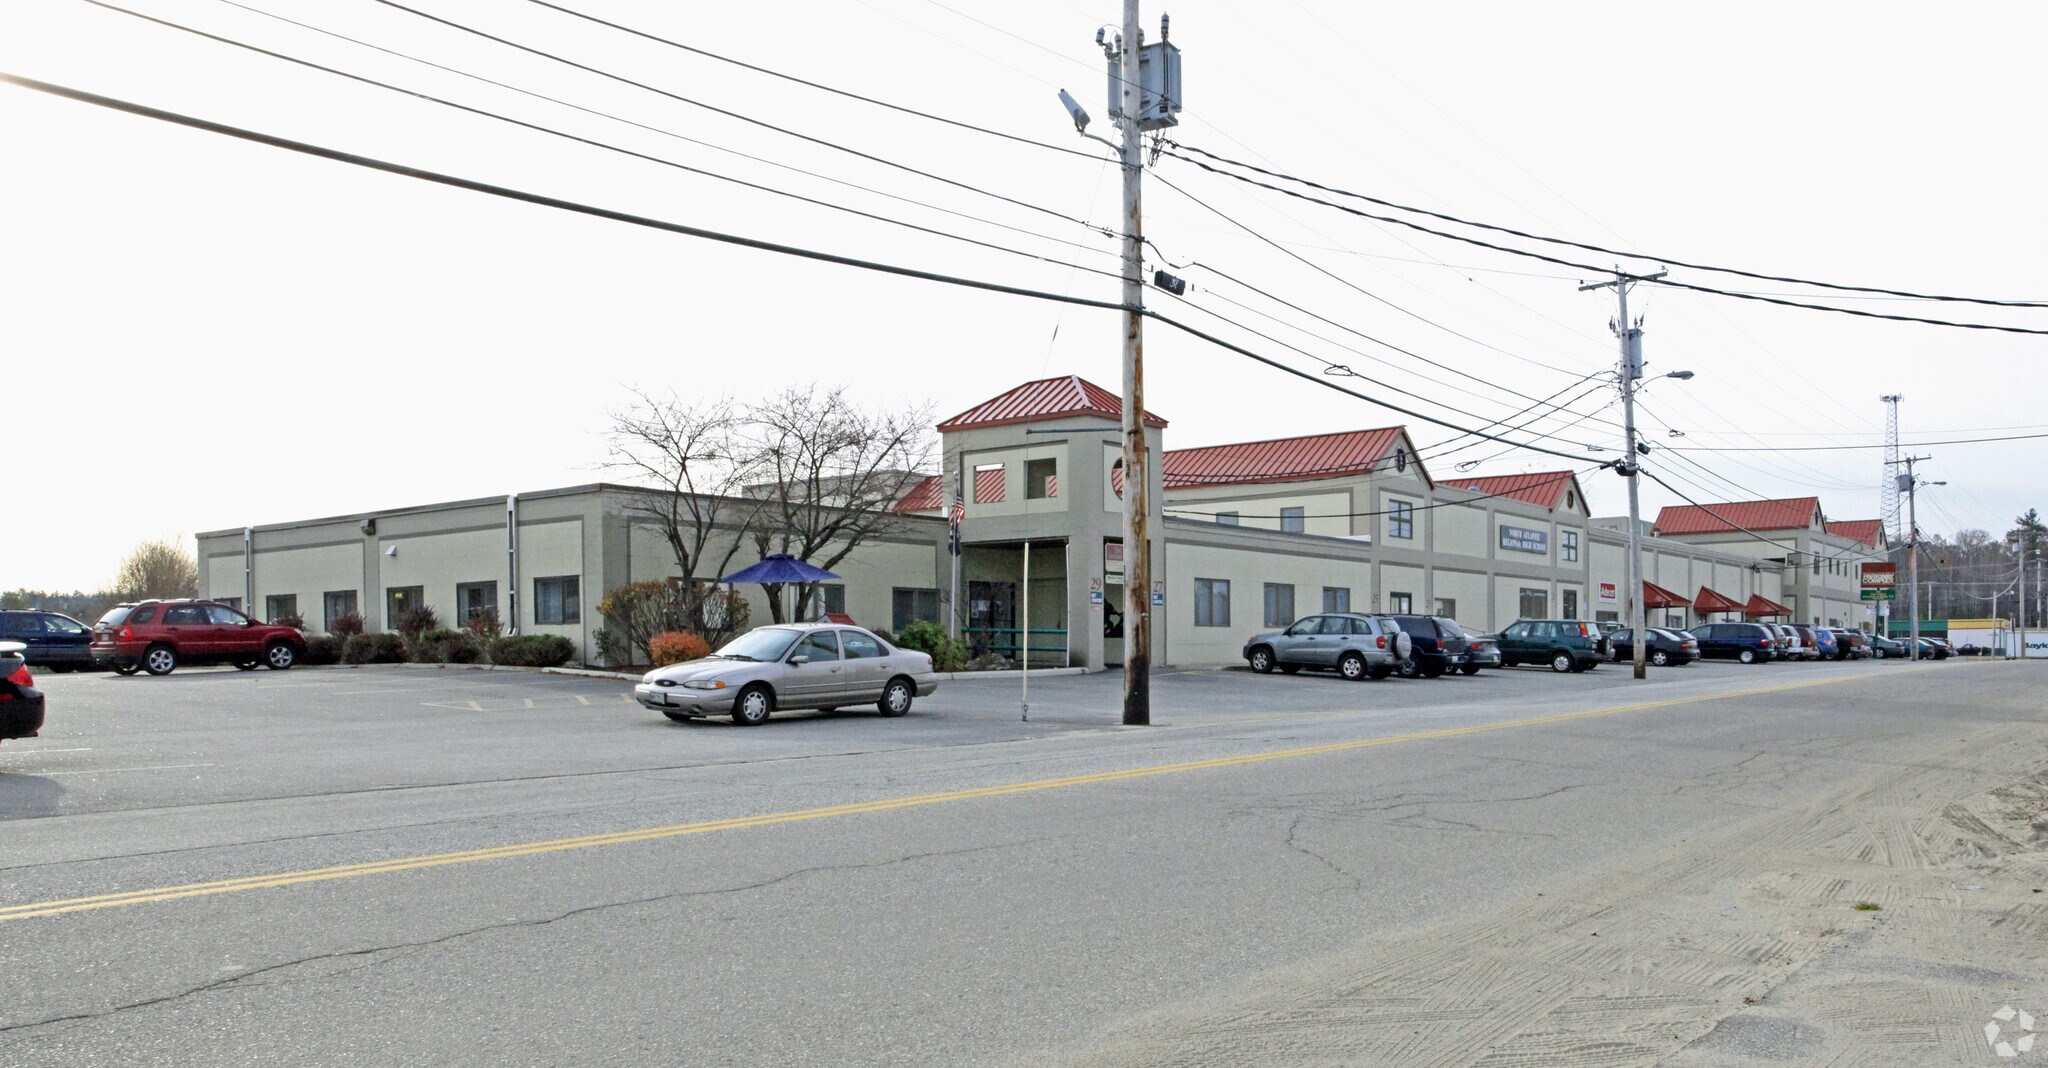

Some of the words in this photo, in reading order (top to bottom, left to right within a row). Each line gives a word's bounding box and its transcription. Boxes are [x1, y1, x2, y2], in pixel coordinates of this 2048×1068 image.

[1509, 529, 1522, 538] NORTH
[1524, 532, 1540, 540] ATLANTIC
[1502, 537, 1521, 548] REGIONAL
[1522, 540, 1532, 549] HIGH
[1532, 541, 1546, 551] SCHOOL
[1090, 577, 1102, 591] 29
[1152, 581, 1163, 593] 27
